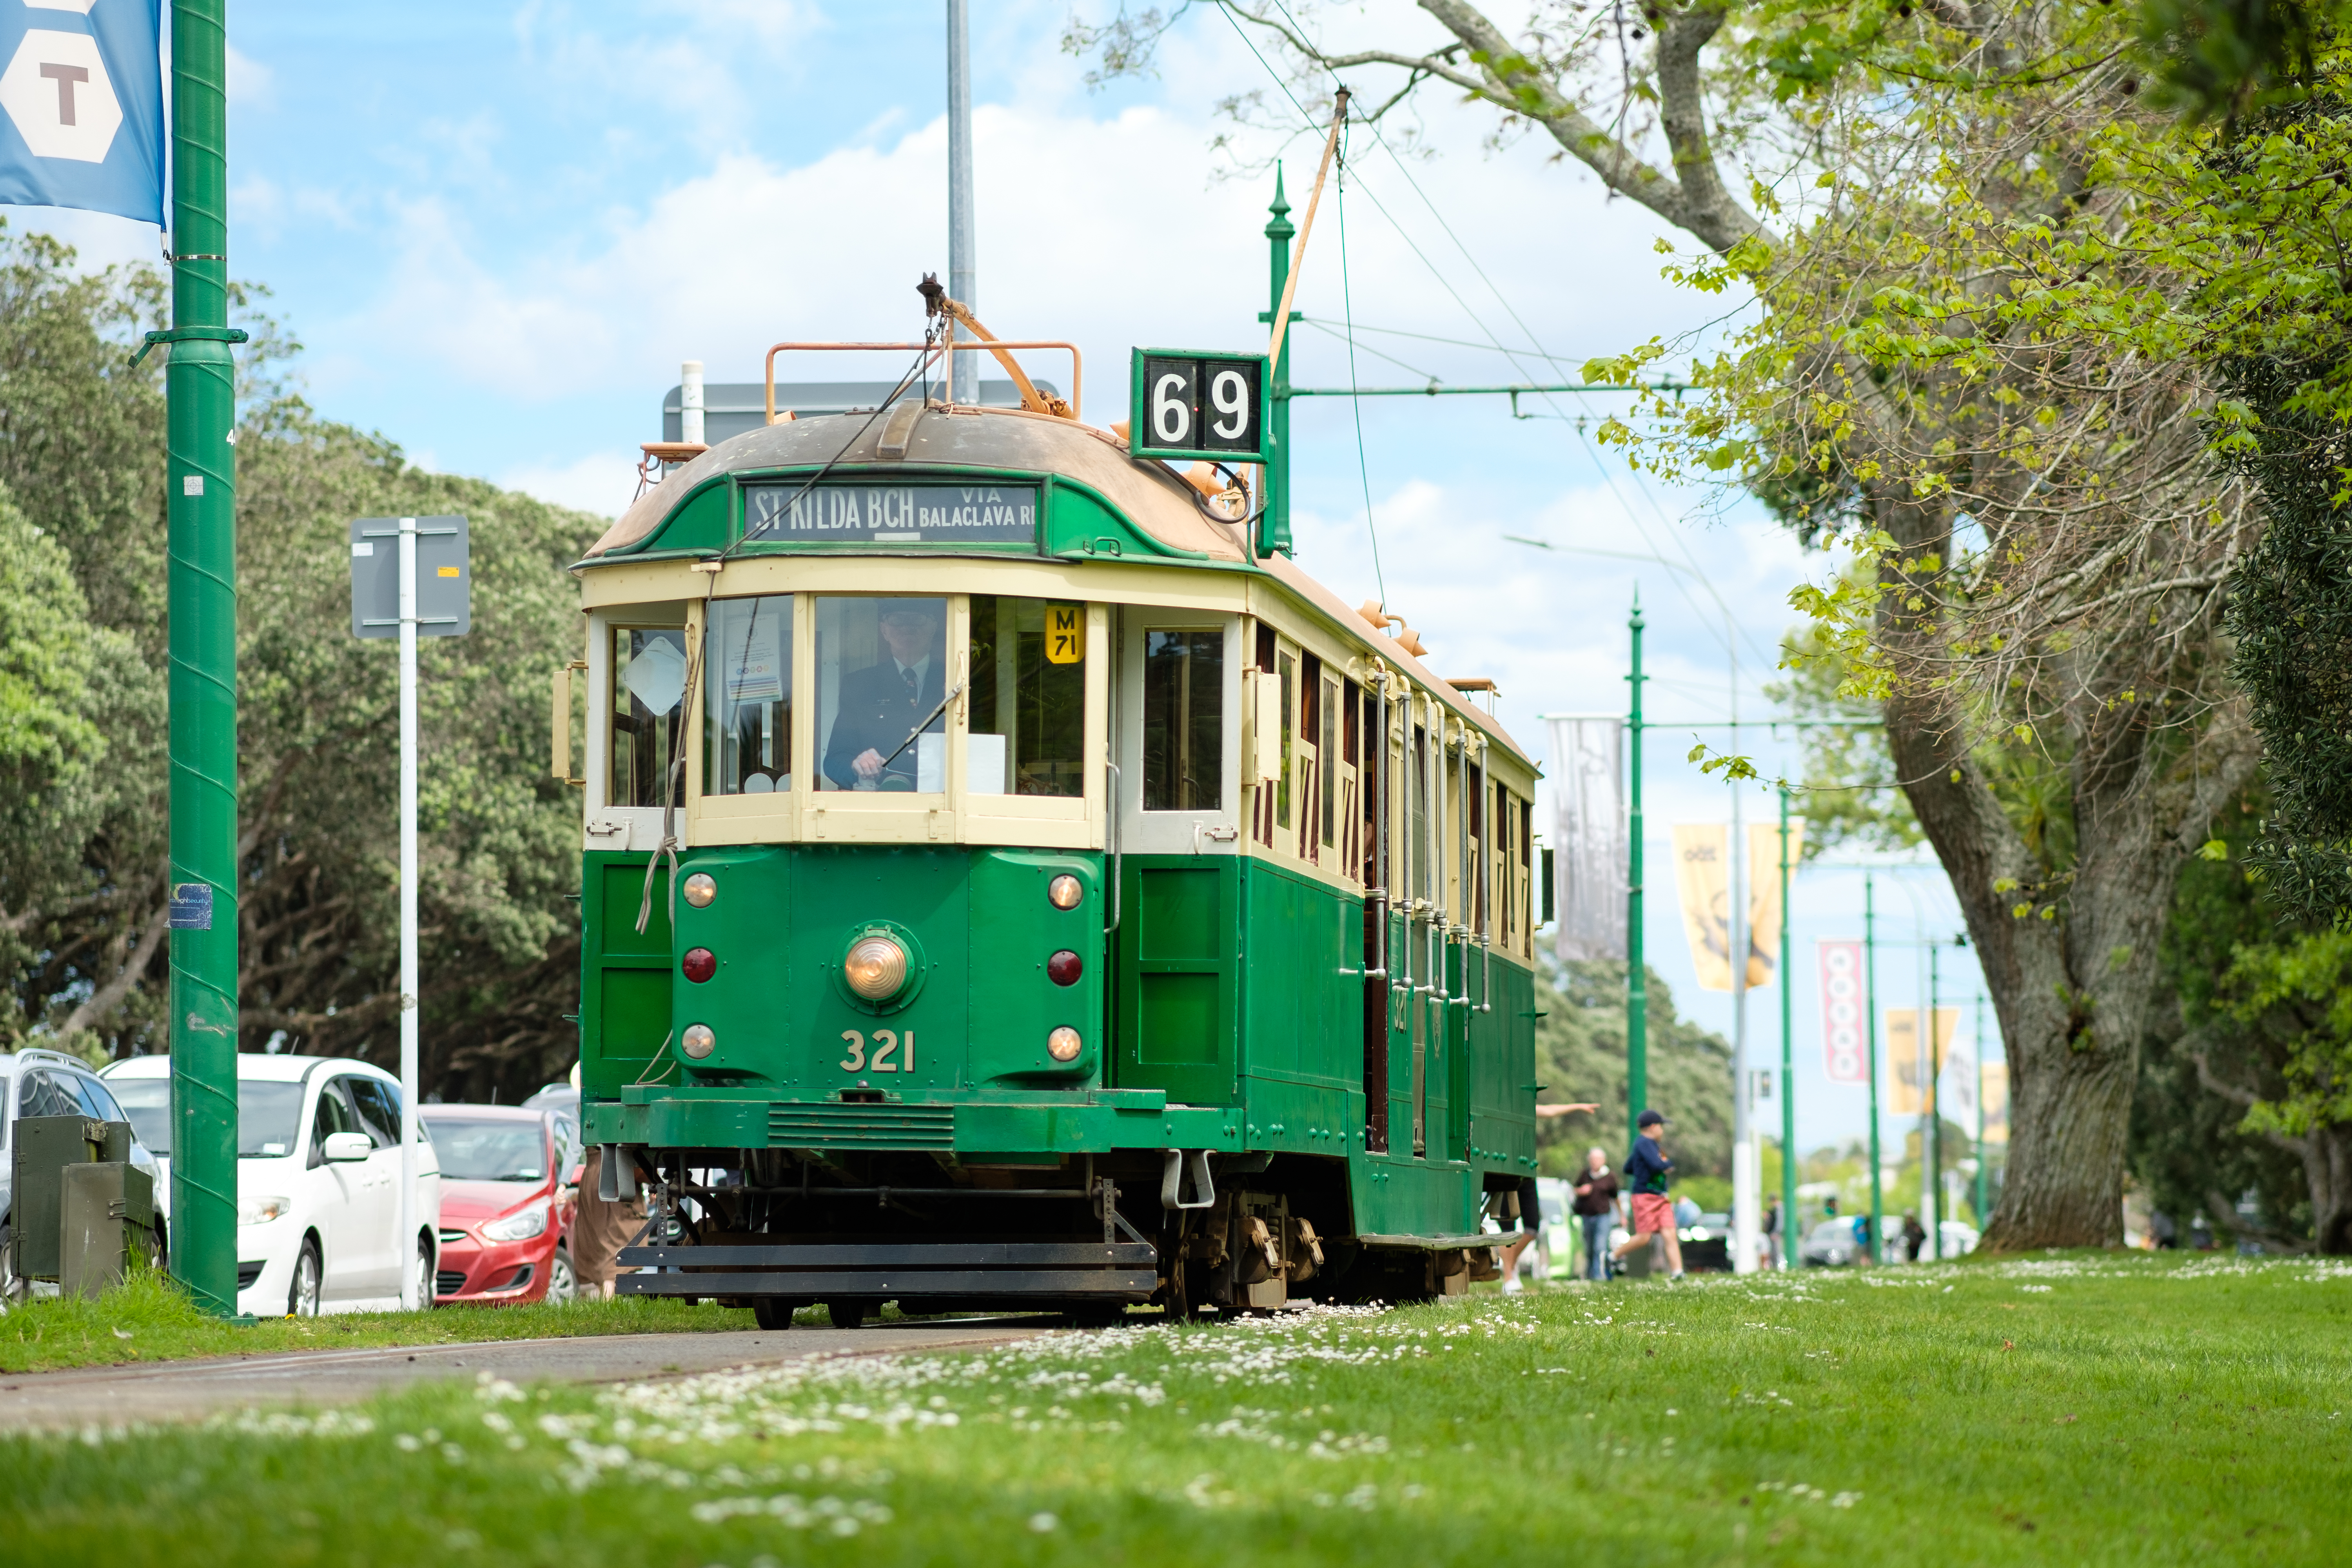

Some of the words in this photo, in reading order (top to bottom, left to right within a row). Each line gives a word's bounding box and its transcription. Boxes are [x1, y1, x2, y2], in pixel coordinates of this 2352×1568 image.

[40, 62, 89, 126] T
[960, 488, 1002, 503] VIA
[755, 491, 783, 530] ST
[790, 490, 862, 529] KILDA
[867, 488, 914, 528] BCH
[919, 506, 1015, 527] BALACLAVA
[1056, 610, 1075, 630] M
[1055, 635, 1076, 656] 71
[839, 1029, 915, 1073] 321
